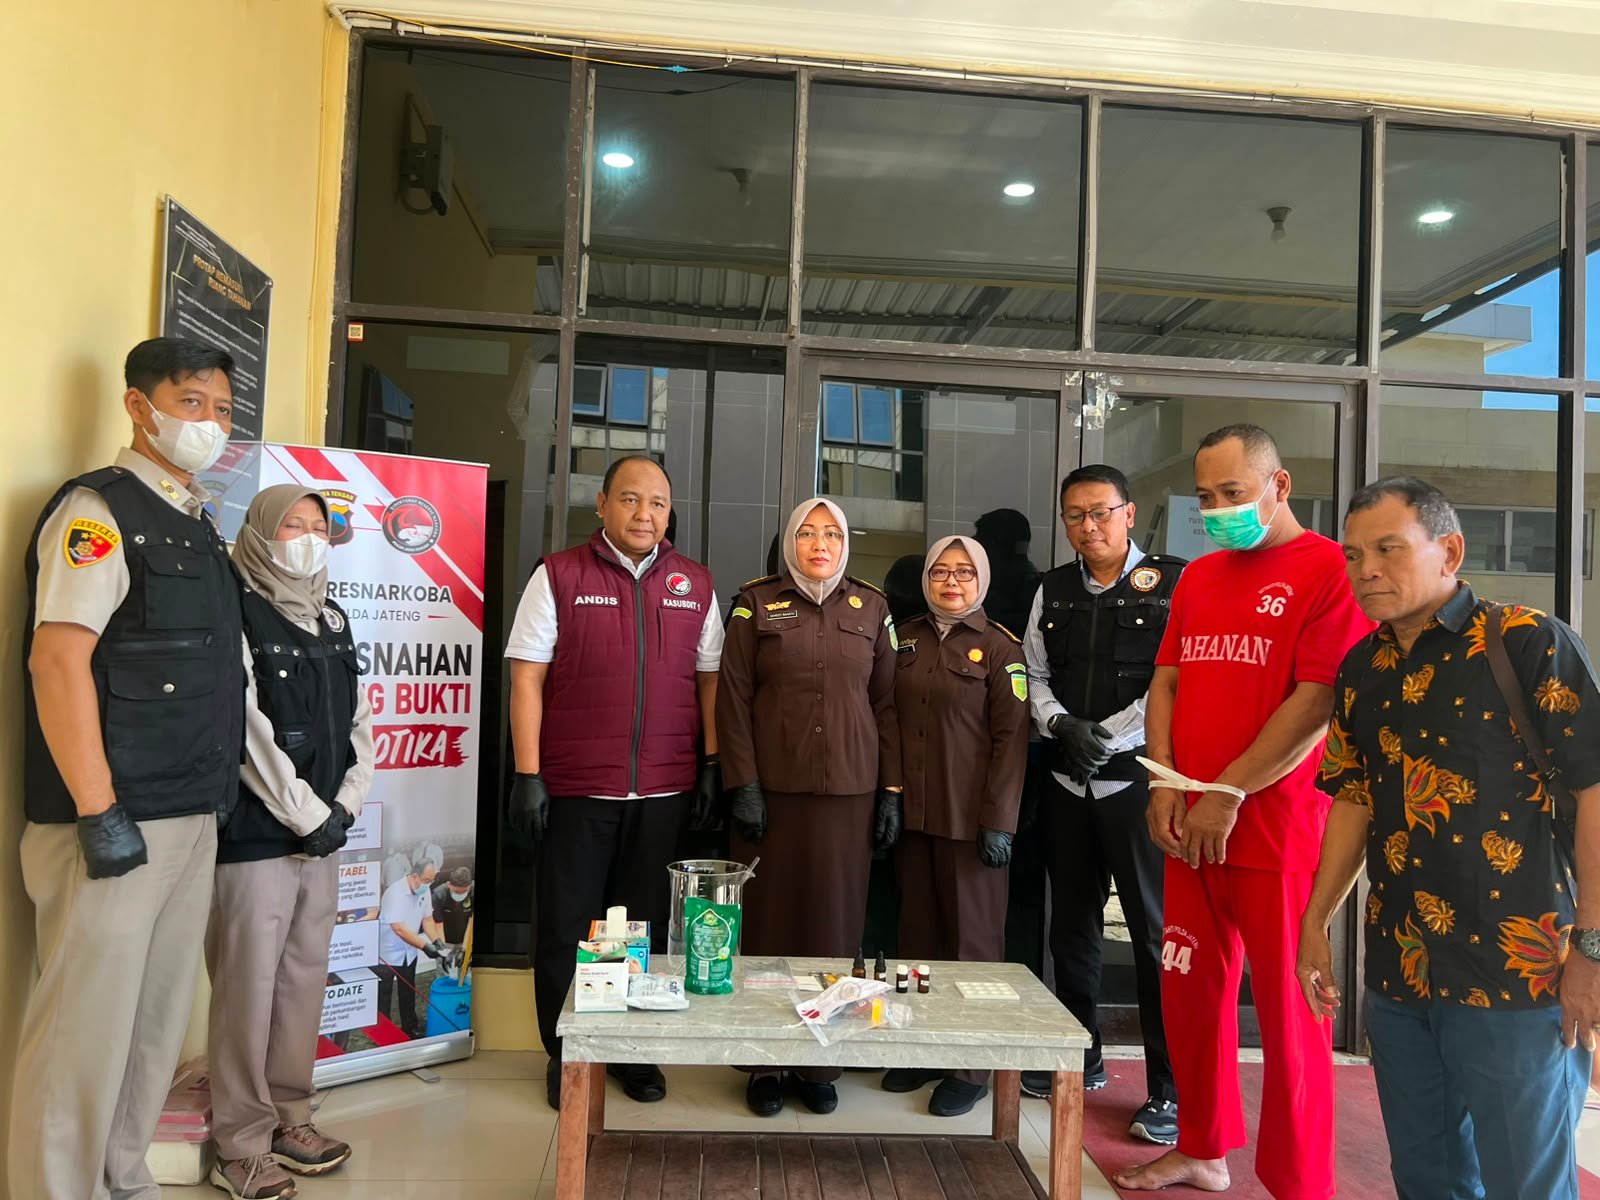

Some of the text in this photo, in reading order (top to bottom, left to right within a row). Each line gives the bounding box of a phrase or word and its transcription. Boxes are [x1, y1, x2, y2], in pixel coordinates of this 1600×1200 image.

[73, 519, 119, 543] RESERSE
[326, 581, 451, 603] RESNARKOBA
[574, 595, 618, 605] ANDIS
[347, 608, 421, 622] LDA JATENG
[663, 598, 697, 610] KASUBDIT
[1255, 594, 1287, 617] 36
[356, 641, 472, 676] SNAHAN
[395, 683, 471, 715] BUKTI
[373, 728, 447, 765] OTIKA
[339, 866, 368, 877] TABEL
[1162, 940, 1192, 975] 44
[337, 984, 364, 998] DATE
